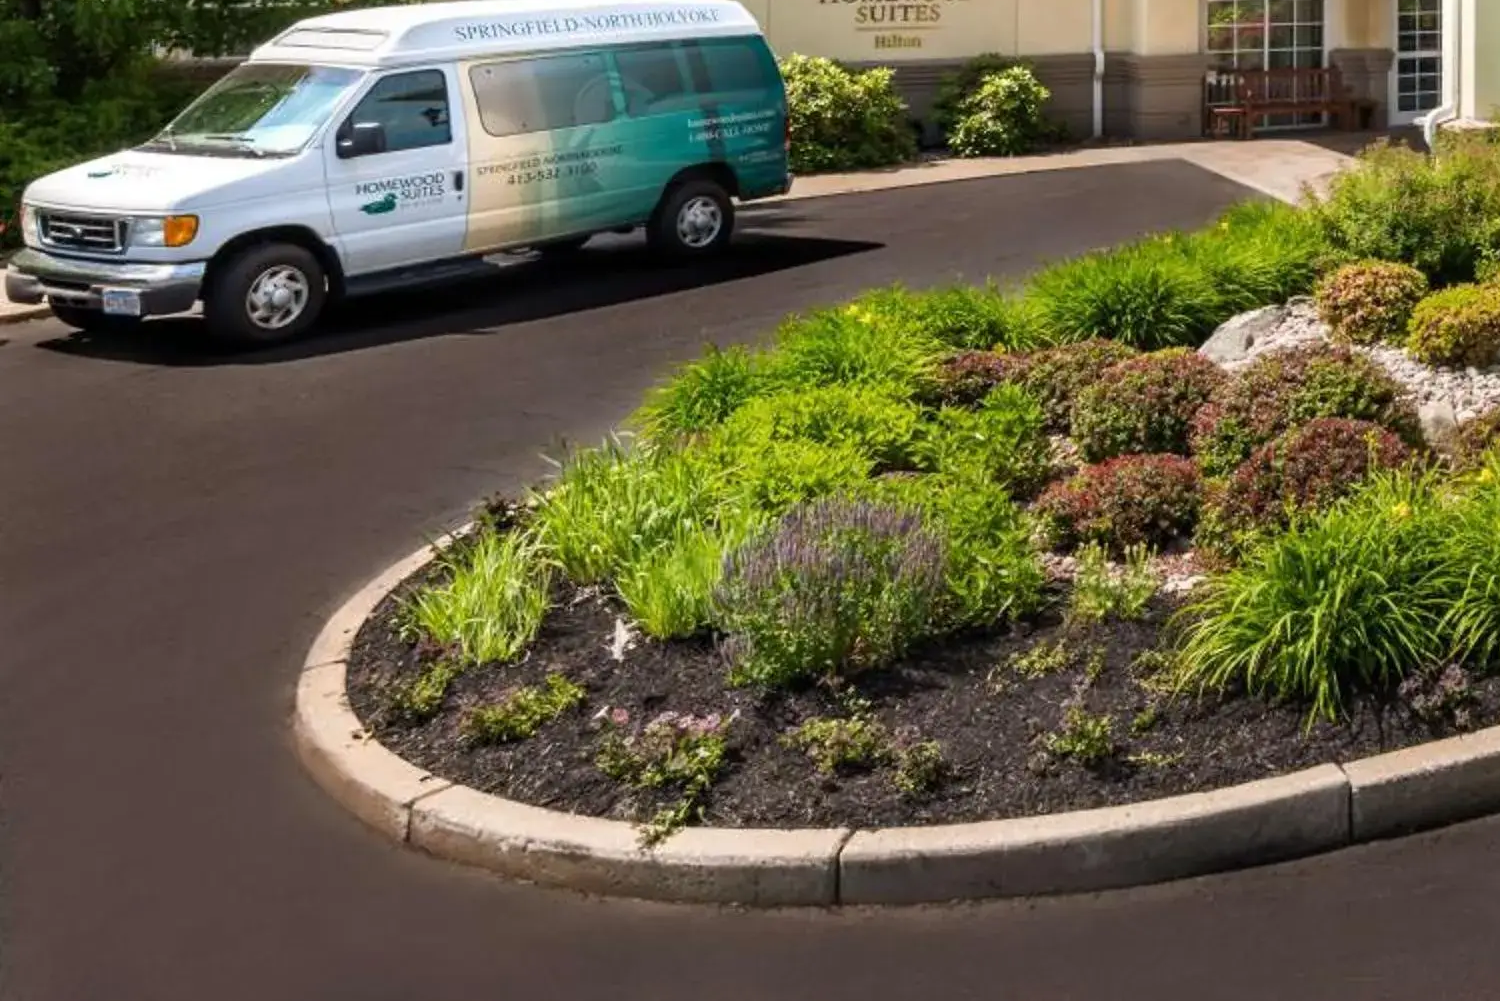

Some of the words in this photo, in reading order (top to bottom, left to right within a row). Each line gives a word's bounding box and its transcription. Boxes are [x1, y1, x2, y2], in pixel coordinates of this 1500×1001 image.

[854, 3, 942, 24] SUITES
[874, 34, 922, 49] Hilton
[355, 171, 445, 195] HOMEWOOD
[401, 185, 445, 200] SUITES
